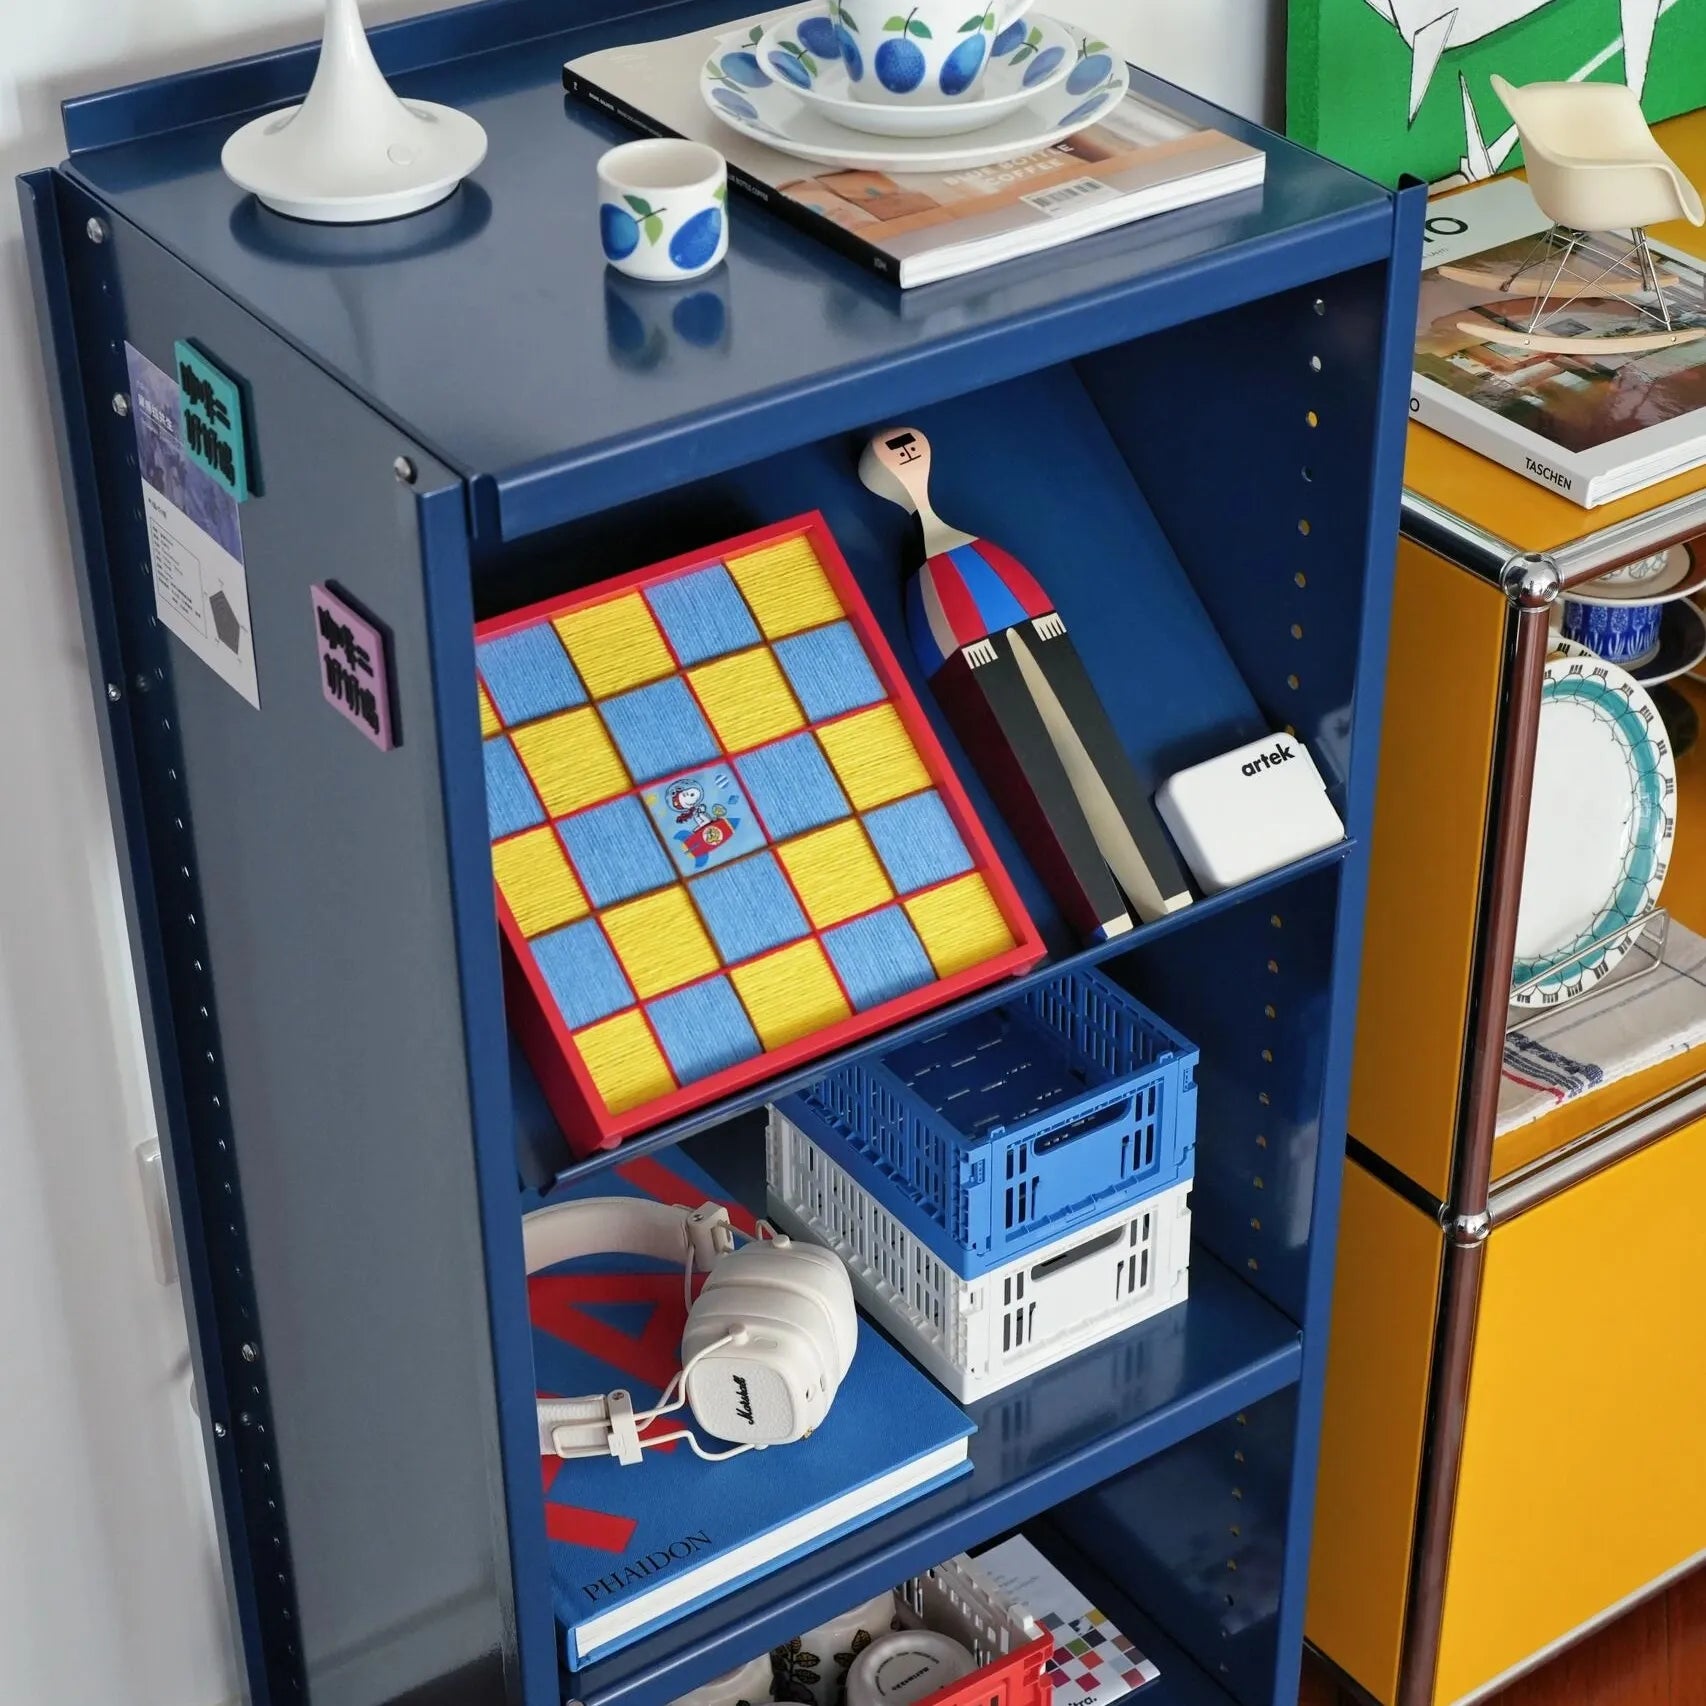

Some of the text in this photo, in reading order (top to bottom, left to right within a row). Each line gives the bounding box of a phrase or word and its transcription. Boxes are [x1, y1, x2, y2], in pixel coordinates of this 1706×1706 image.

[1525, 457, 1573, 491] TASCHEN
[1241, 743, 1296, 777] artek
[732, 1374, 754, 1426] Marshall
[582, 1529, 713, 1602] PHAIDON
